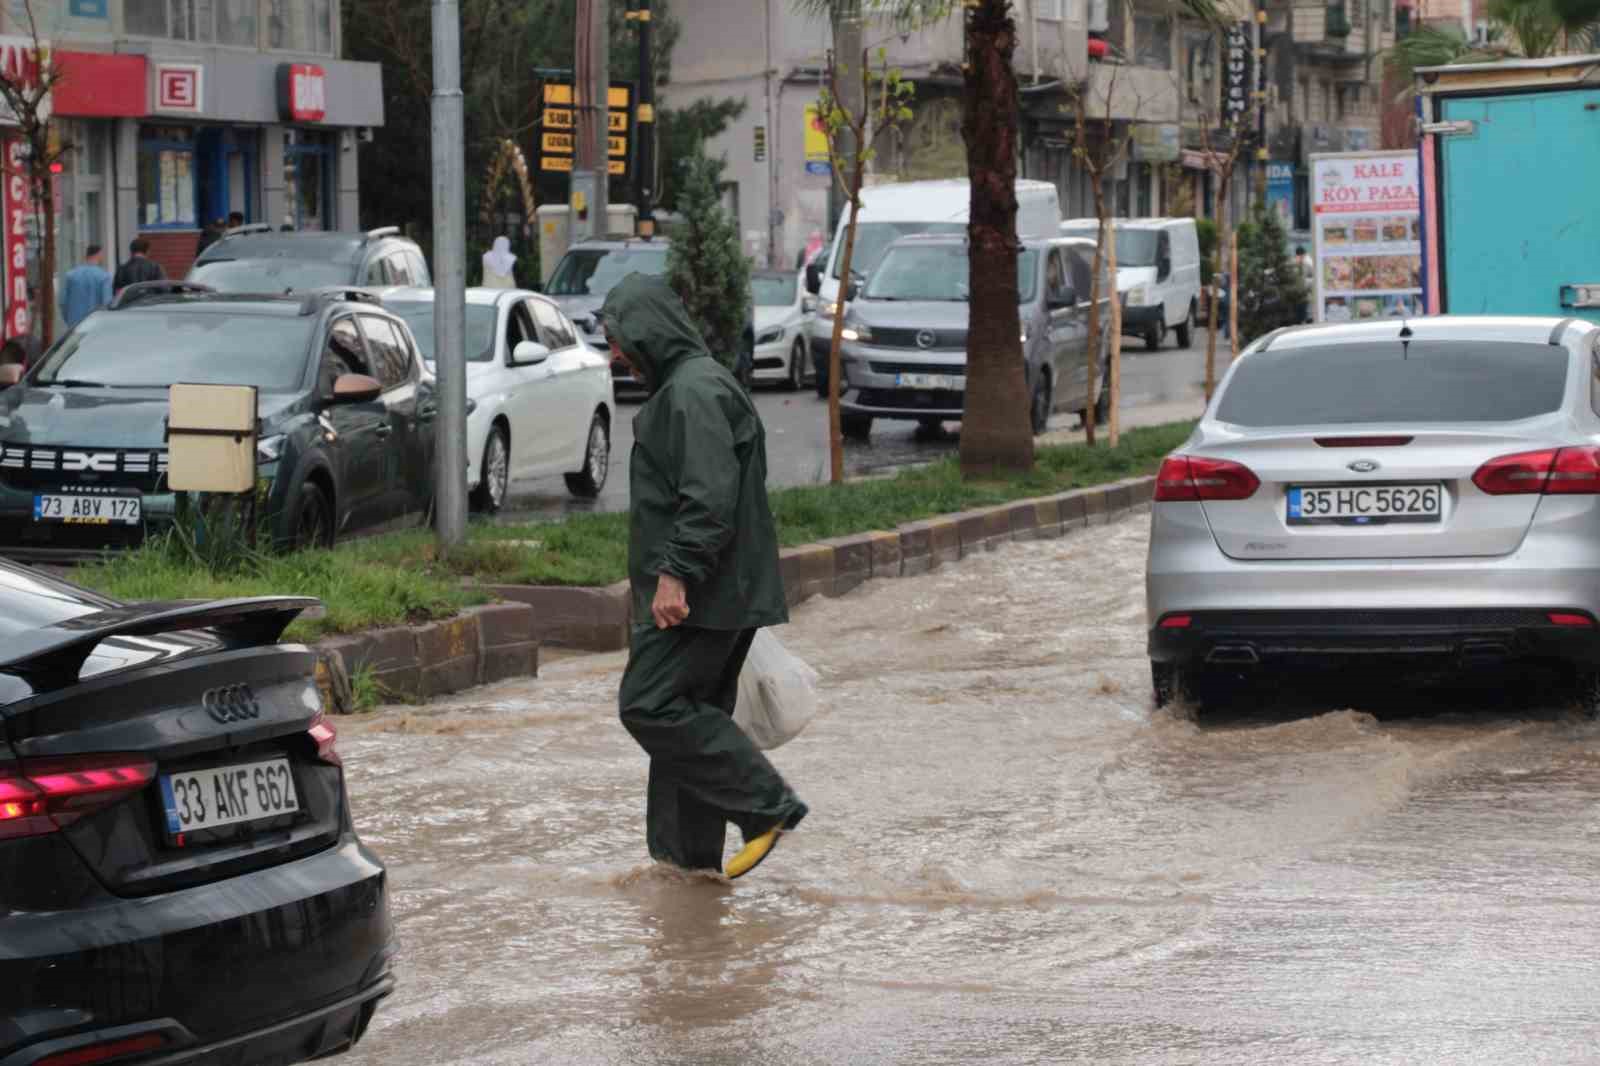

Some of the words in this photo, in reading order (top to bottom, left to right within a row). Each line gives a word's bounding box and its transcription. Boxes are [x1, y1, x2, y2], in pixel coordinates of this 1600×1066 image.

[168, 76, 188, 100] E
[1353, 162, 1404, 178] KALE
[42, 497, 62, 515] 73
[72, 498, 102, 516] ABV
[111, 499, 138, 518] 172
[1303, 490, 1331, 514] 35
[1337, 490, 1372, 513] HC
[1376, 488, 1437, 513] 5626
[174, 777, 206, 825] 33
[213, 769, 249, 820] AKF
[254, 763, 296, 812] 662
